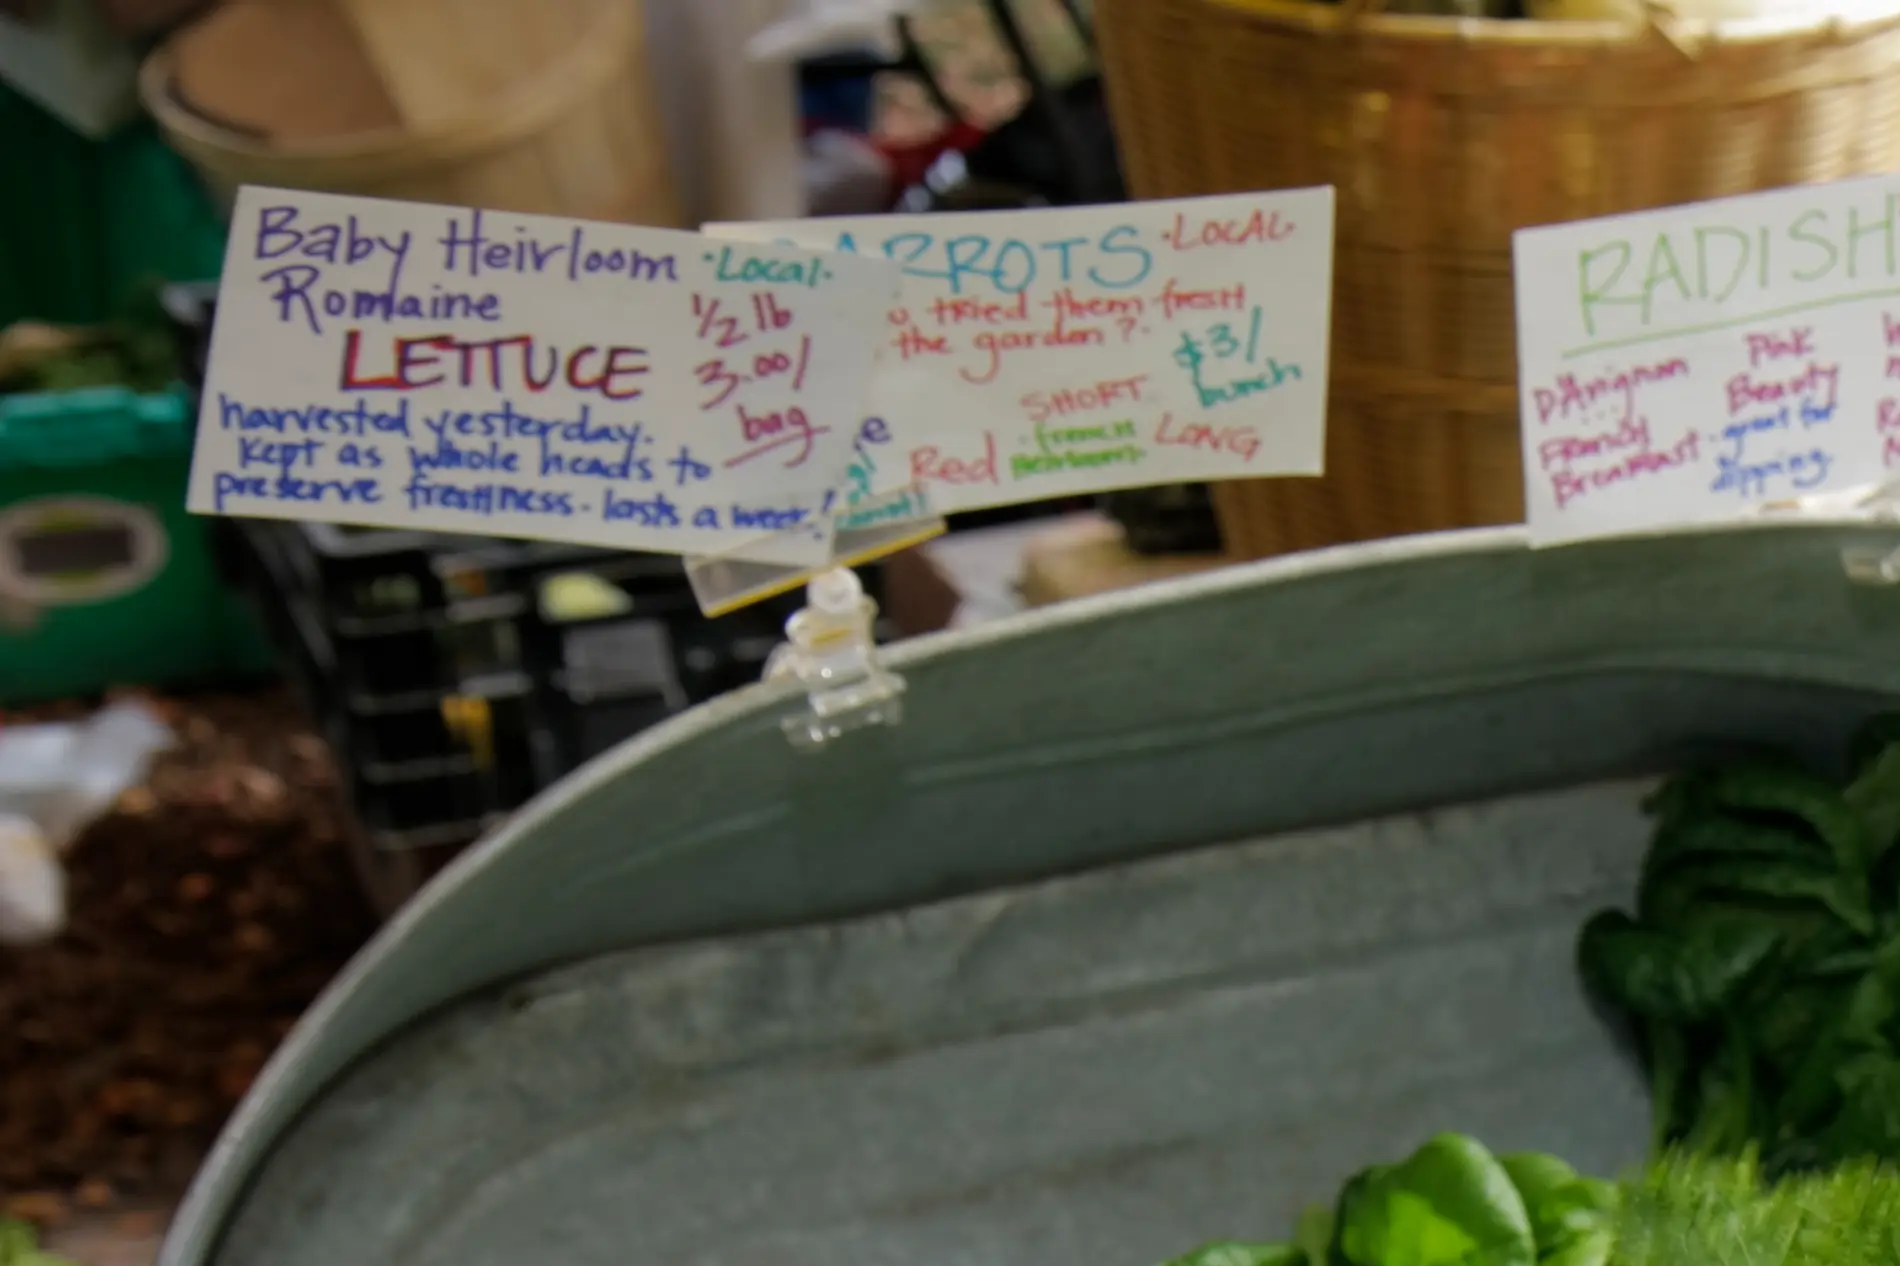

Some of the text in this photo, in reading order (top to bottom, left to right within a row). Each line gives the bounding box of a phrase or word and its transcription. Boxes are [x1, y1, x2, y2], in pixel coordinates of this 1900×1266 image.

[255, 206, 679, 286] Baby Heirloom
[1576, 190, 1899, 337] RADISH
[261, 265, 504, 333] Romaine
[753, 293, 793, 329] lb
[339, 329, 650, 399] LETTUCE
[218, 392, 410, 438] harvested
[1019, 374, 1149, 421] SHORT
[337, 443, 384, 469] as
[407, 440, 520, 473] whole
[540, 448, 654, 483] heads
[666, 445, 712, 485] to
[732, 404, 822, 467] bag
[908, 429, 1000, 486] Red
[1154, 410, 1262, 462] LONG
[213, 471, 384, 513] preserve
[603, 487, 682, 529] lasts
[692, 508, 721, 531] a
